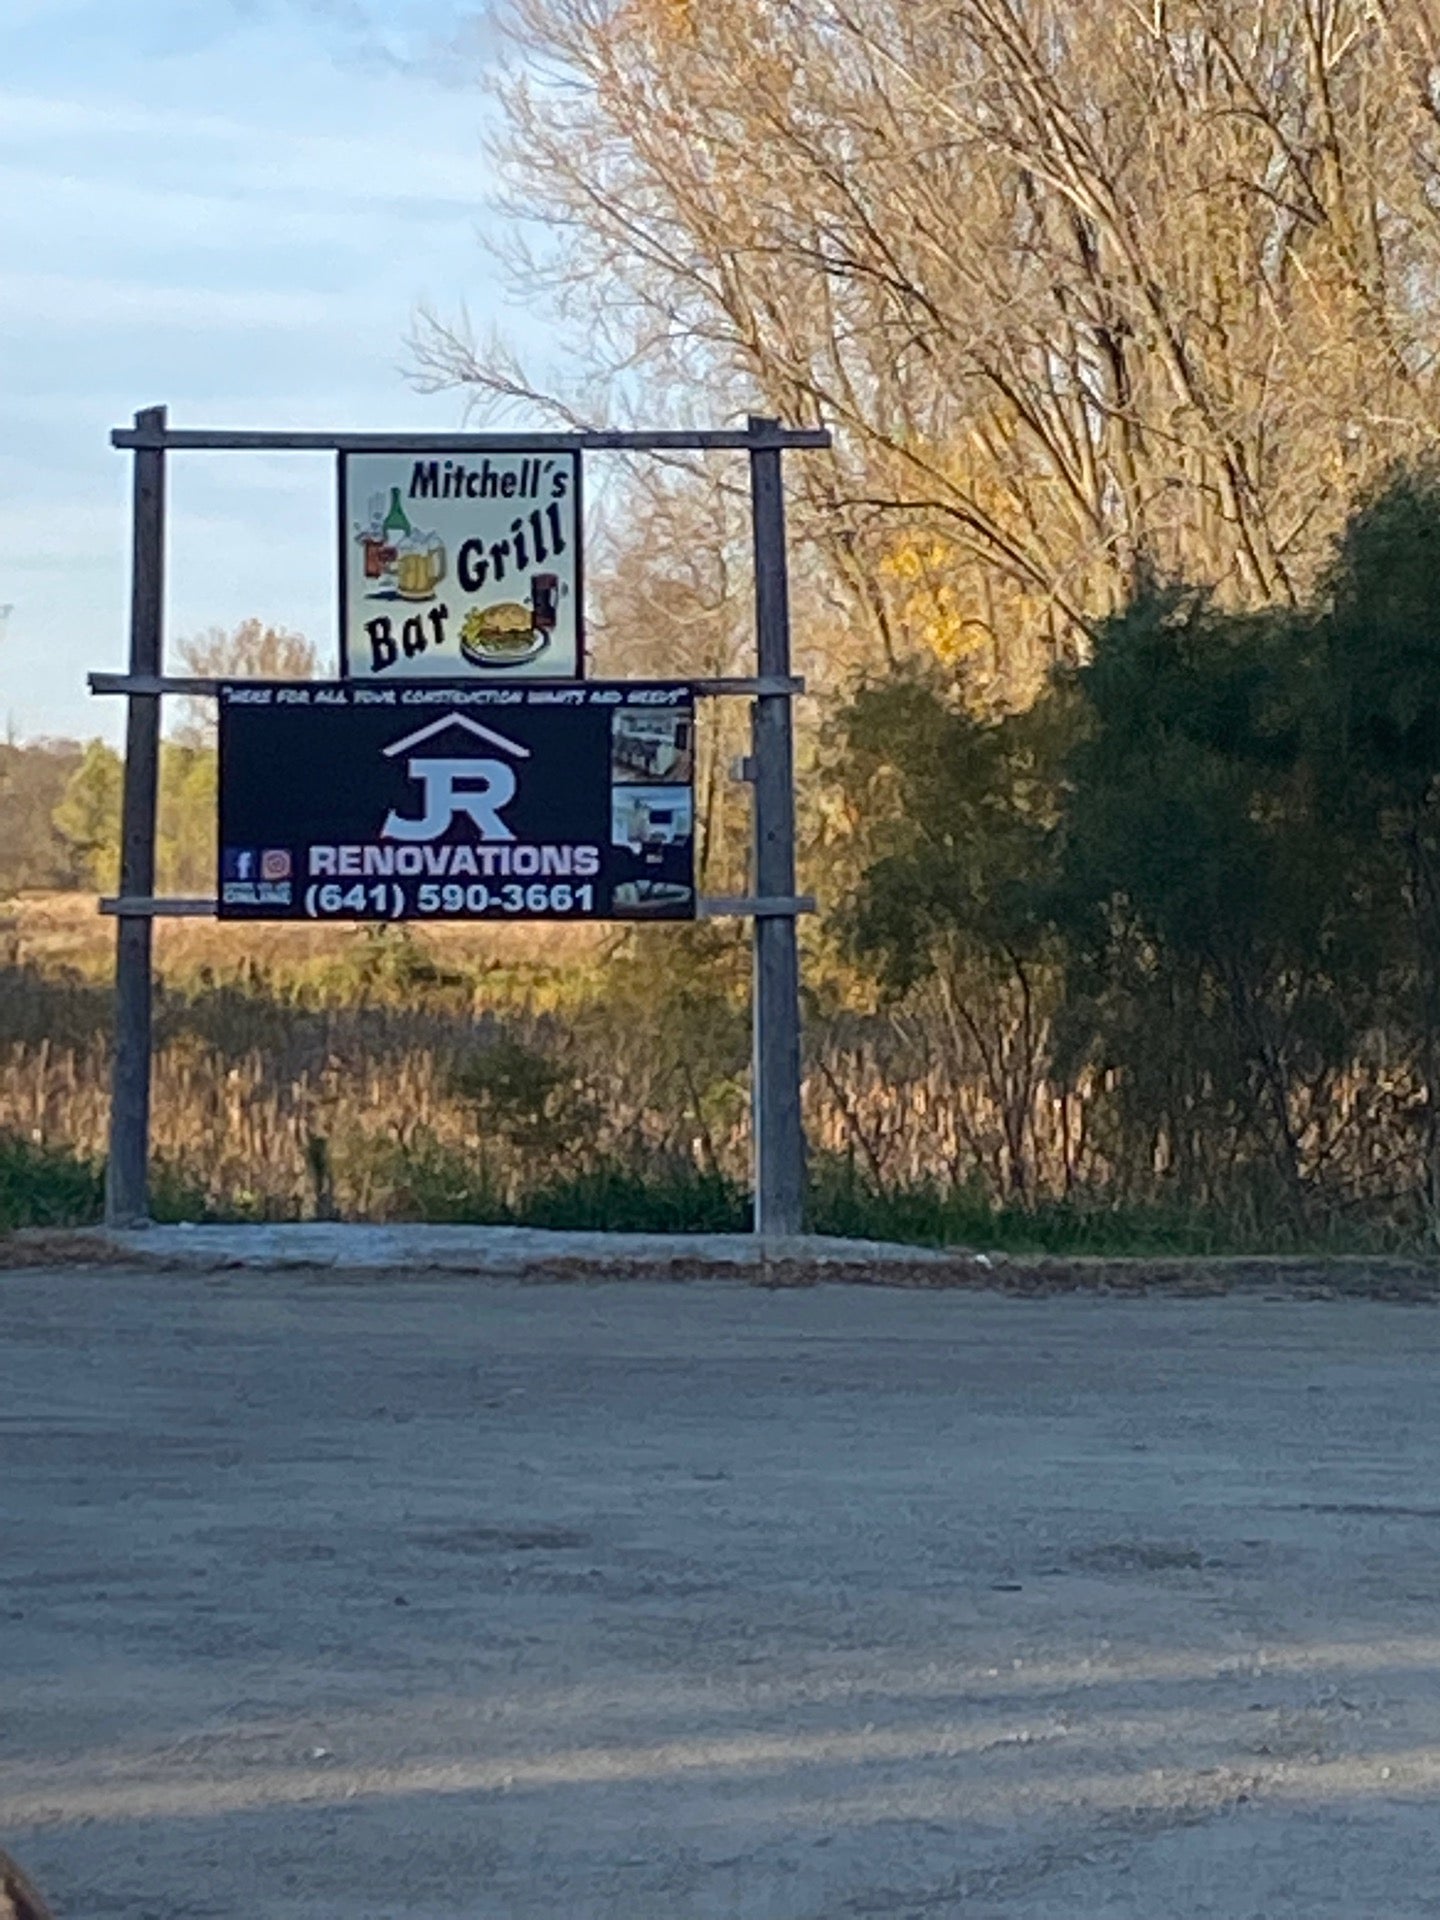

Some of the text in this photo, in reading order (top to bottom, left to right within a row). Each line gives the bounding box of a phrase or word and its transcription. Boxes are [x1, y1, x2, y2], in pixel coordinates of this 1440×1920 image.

[408, 459, 568, 498] Mitchell's
[457, 502, 566, 592] Grill
[364, 603, 448, 672] Bar
[276, 689, 310, 704] FOR
[314, 689, 348, 704] ALL
[380, 758, 517, 841] JR
[308, 846, 599, 876] RENOVATIONS
[304, 884, 405, 917] (641)
[417, 884, 594, 912] 590-3661
